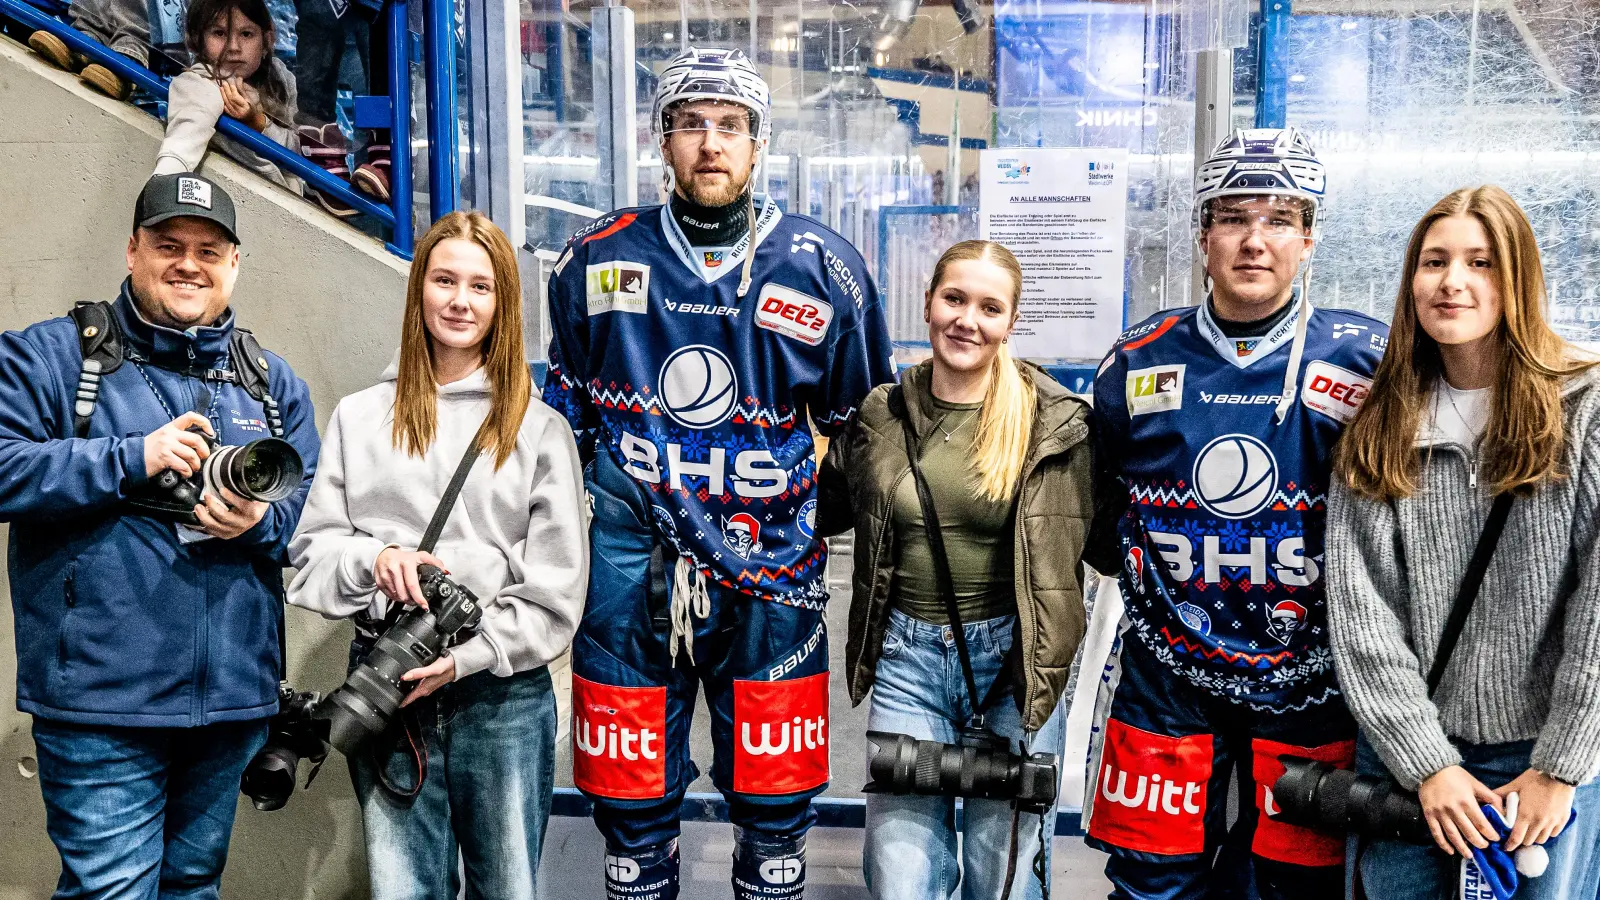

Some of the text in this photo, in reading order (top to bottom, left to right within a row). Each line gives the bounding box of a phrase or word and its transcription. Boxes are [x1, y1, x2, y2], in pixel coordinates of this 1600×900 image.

[825, 249, 863, 309] FISCHER
[678, 303, 741, 317] BAUER
[1213, 394, 1283, 405] BAUER
[1309, 375, 1366, 408] DEL
[620, 430, 788, 498] BHS
[1148, 531, 1320, 587] BHS
[770, 623, 824, 681] BAUER
[764, 881, 805, 894] DONHAU
